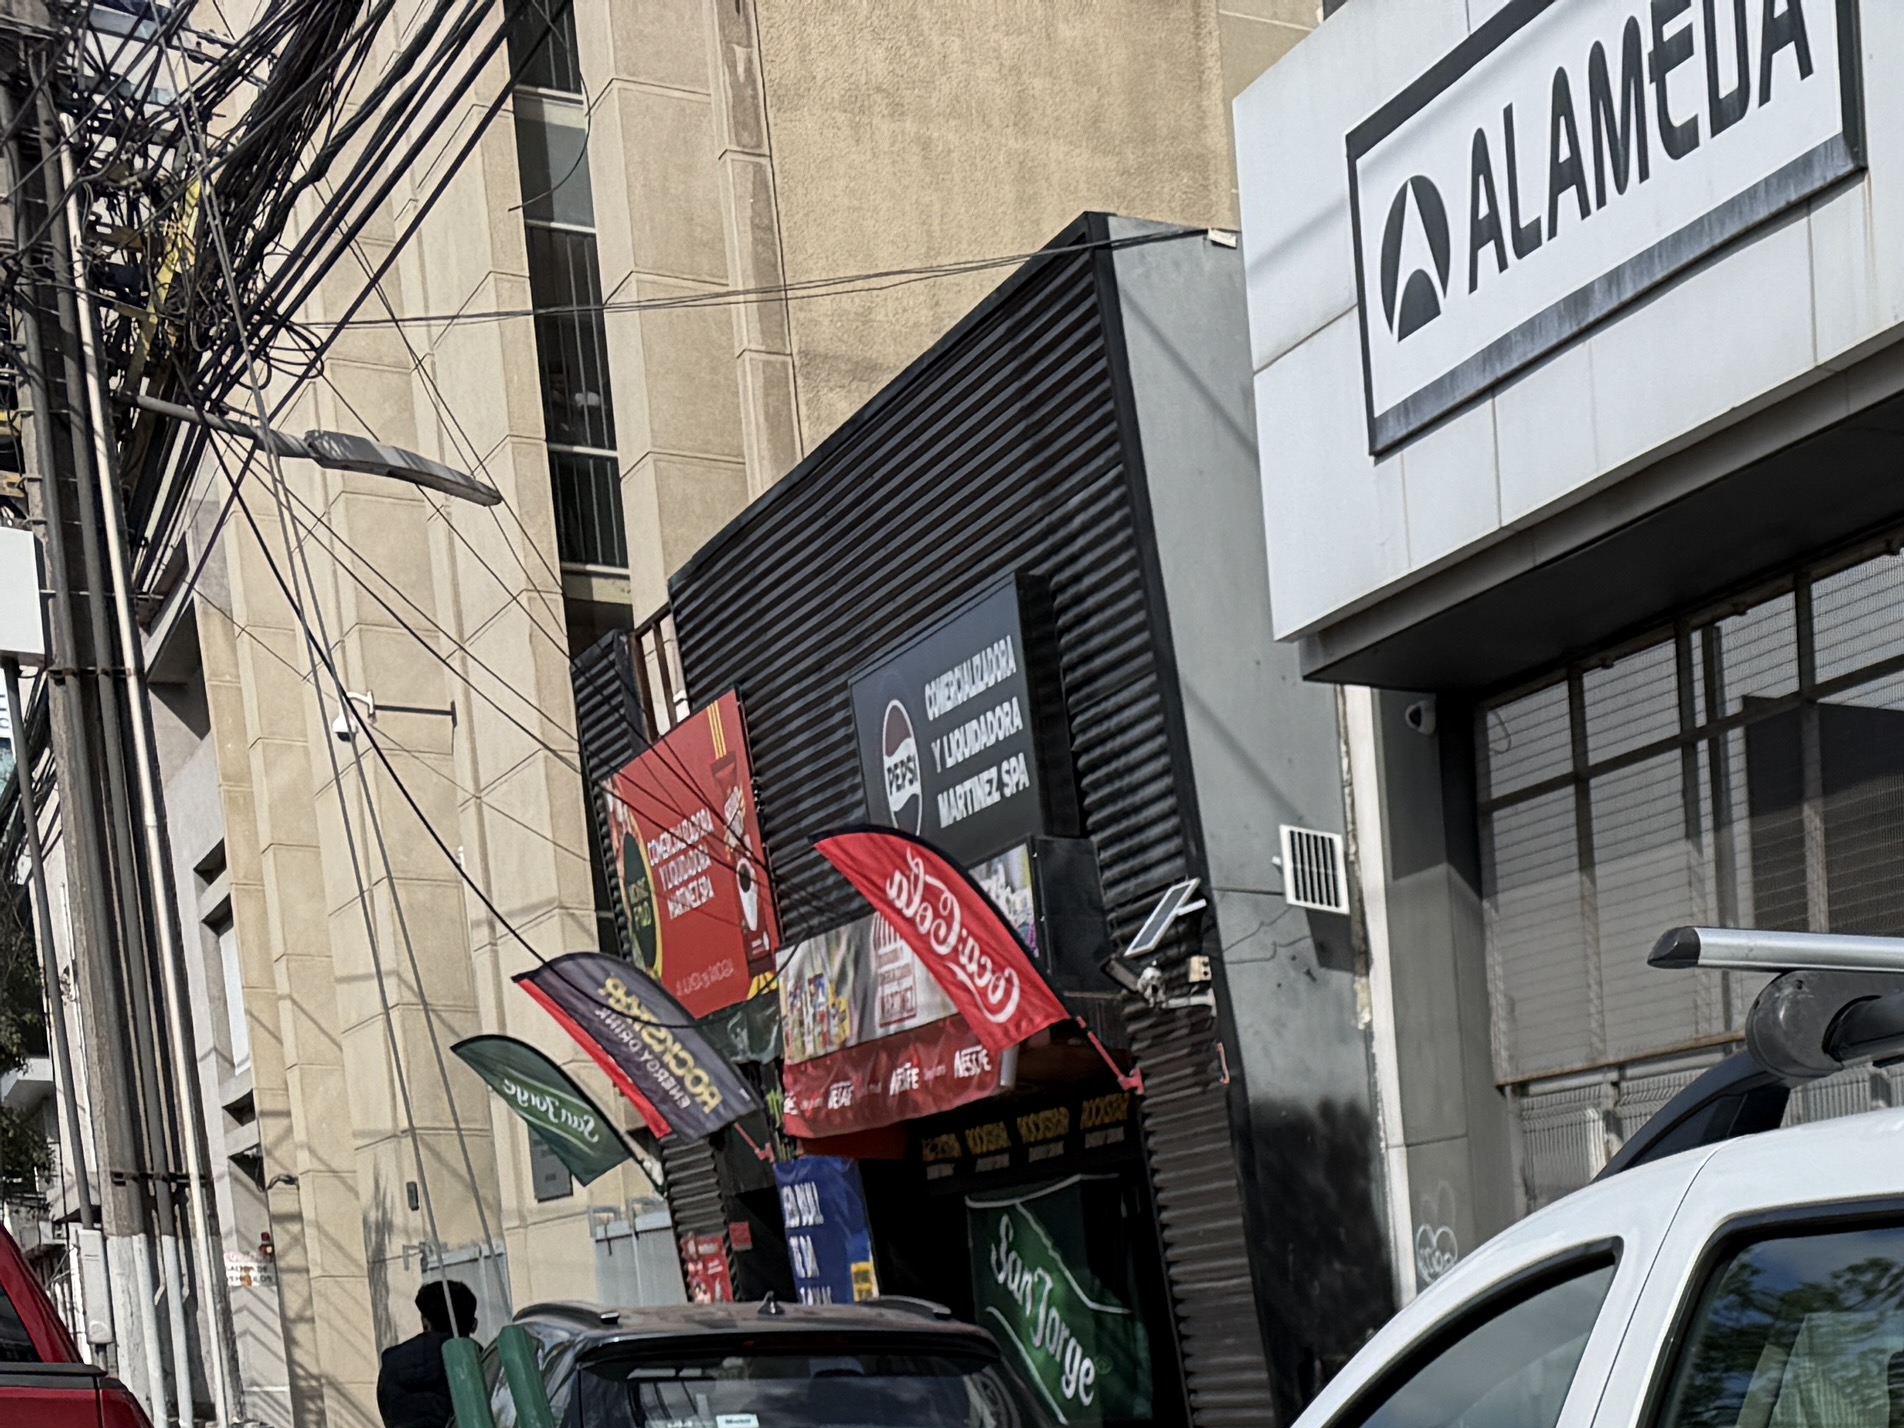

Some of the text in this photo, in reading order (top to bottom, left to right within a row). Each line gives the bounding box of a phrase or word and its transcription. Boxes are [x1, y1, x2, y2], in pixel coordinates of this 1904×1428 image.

[1468, 0, 1815, 295] ALAMEDA
[942, 696, 1023, 768] LIQUIDADORA
[886, 754, 919, 796] PEPSI
[1001, 752, 1030, 798] SPA
[990, 1213, 1033, 1318] San
[1027, 1266, 1097, 1406] Jorge
